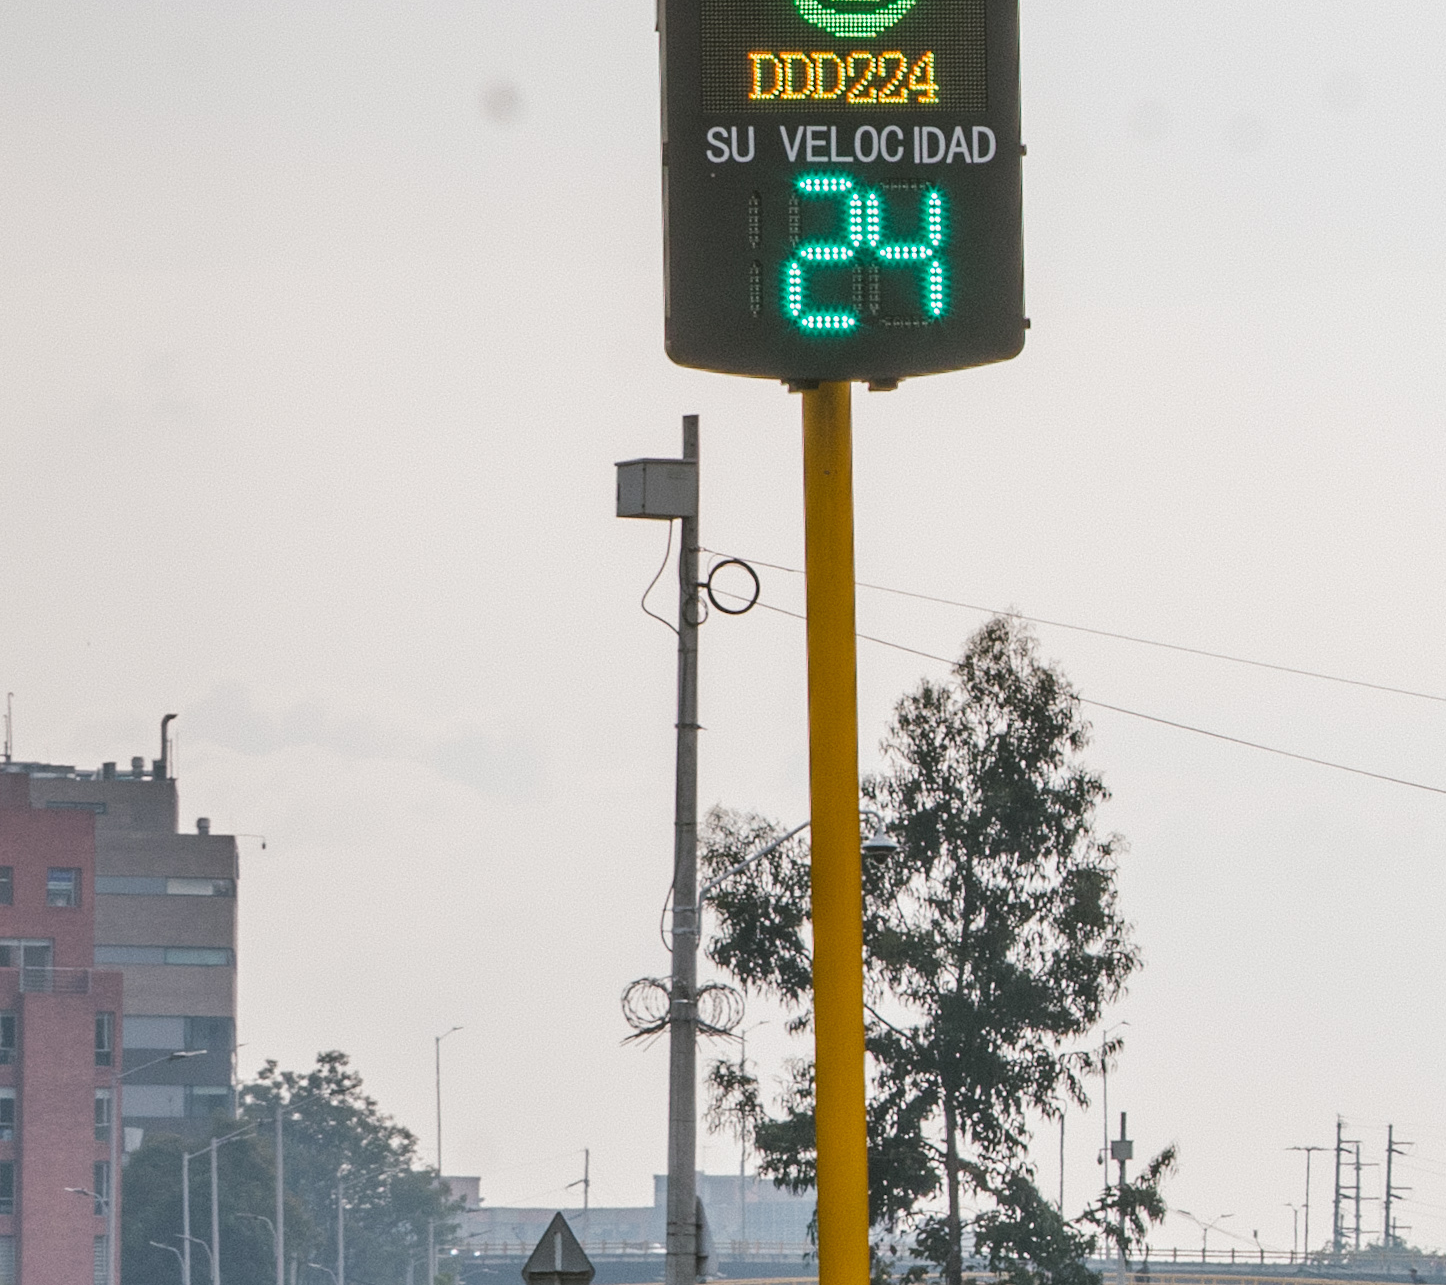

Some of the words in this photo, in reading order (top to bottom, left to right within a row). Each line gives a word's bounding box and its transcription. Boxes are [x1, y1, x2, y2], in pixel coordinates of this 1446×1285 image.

[748, 51, 940, 104] DDD224
[706, 126, 756, 164] SU
[781, 174, 943, 330] 24
